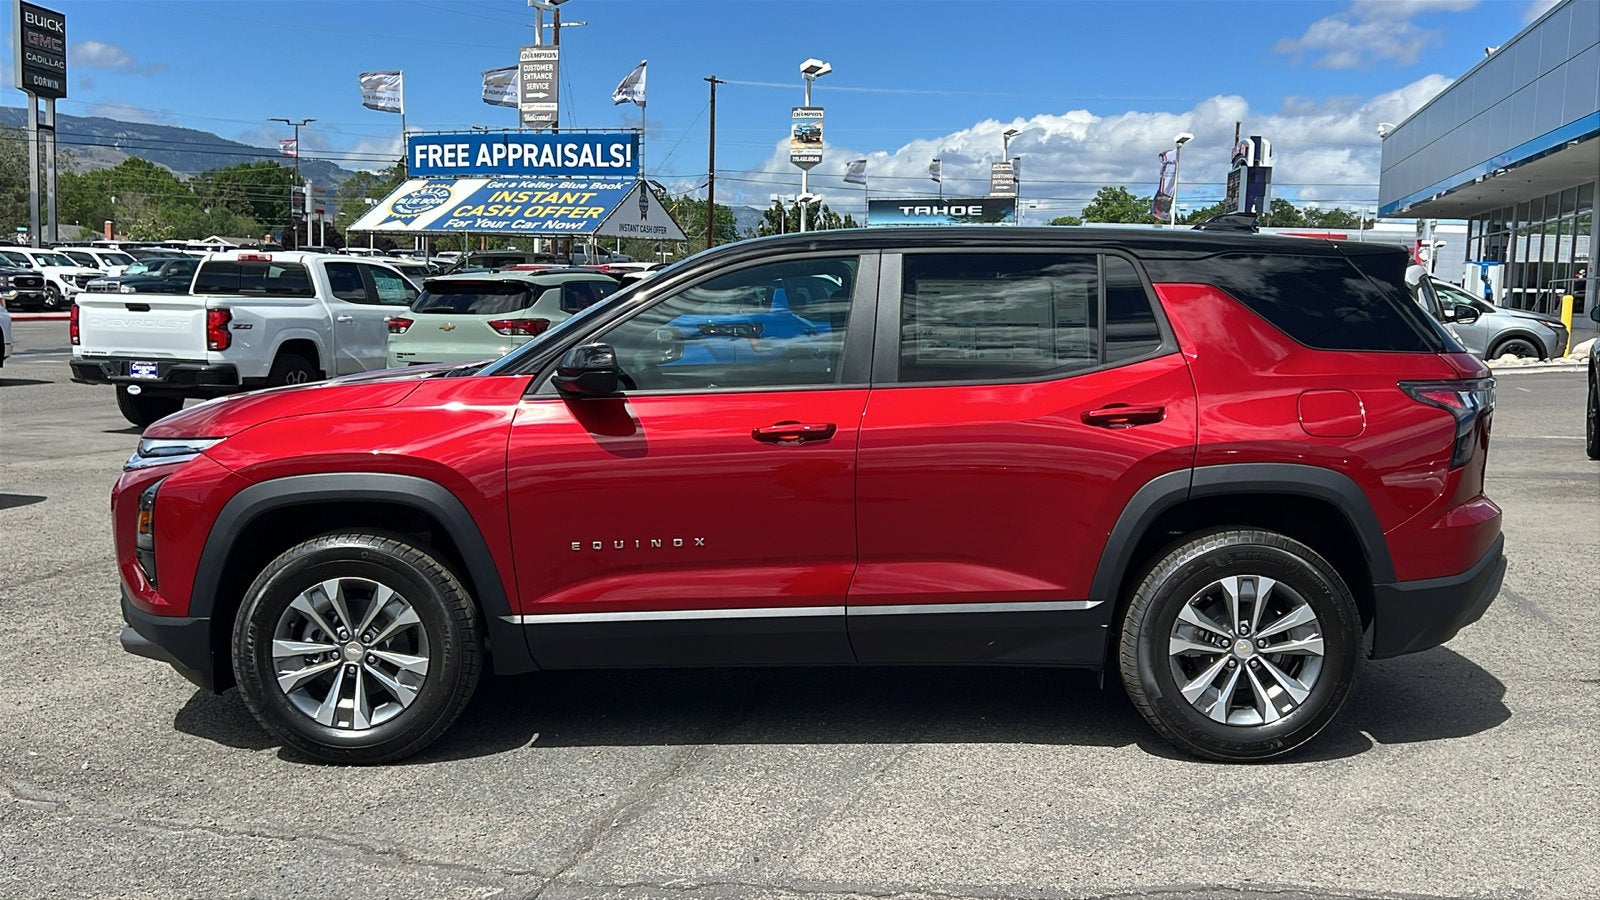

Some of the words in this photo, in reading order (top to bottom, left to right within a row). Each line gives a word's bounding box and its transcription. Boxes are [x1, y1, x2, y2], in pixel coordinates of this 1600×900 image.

[25, 12, 64, 33] BUICK
[27, 31, 63, 52] GMC
[25, 52, 65, 69] CADILLAC
[523, 64, 554, 72] CUSTOMER
[33, 75, 59, 90] CORWIN
[523, 73, 553, 81] ENTRANCE
[523, 113, 552, 121] Welcome!
[415, 143, 470, 168] FREE
[475, 143, 632, 168] APPRAISALS!
[486, 181, 507, 189] Get
[518, 181, 554, 190] Kelley
[558, 182, 588, 190] Blue
[487, 191, 598, 205] INSTANT
[452, 205, 521, 218] CASH
[523, 206, 605, 219] OFFER
[899, 205, 983, 216] TAHOE
[443, 219, 471, 229] For
[473, 219, 511, 230] Your
[511, 219, 541, 230] Car
[542, 220, 589, 230] Now!
[619, 223, 640, 233] INSTANT
[640, 225, 653, 234] CASH
[653, 225, 667, 235] OFFER
[88, 318, 193, 330] CHEVROLET
[571, 537, 705, 550] EQUINOX
